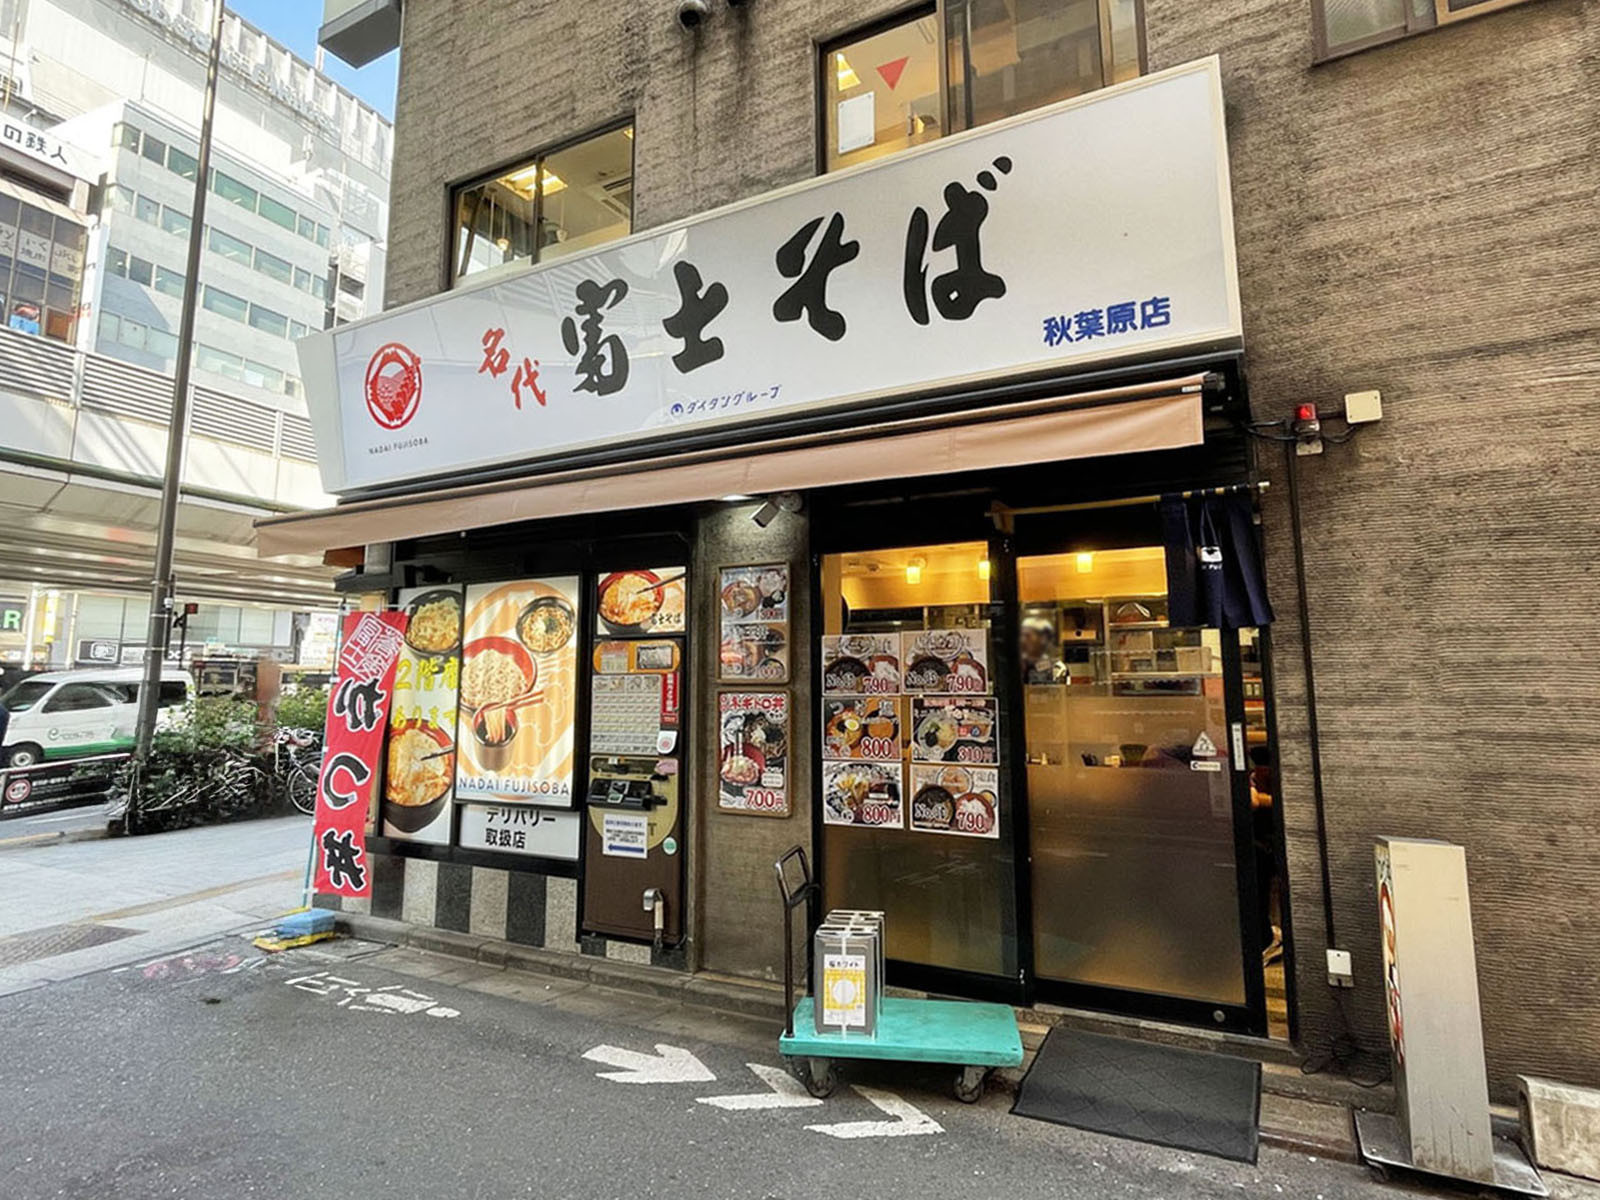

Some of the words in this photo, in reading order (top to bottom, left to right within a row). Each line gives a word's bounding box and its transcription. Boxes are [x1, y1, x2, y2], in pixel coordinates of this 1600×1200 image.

[4, 124, 68, 165] の鉄人
[1043, 296, 1171, 346] 秋葉原店
[478, 328, 547, 410] 名代
[687, 384, 782, 414] ダイタングループ
[459, 776, 500, 790] NADAI
[503, 780, 570, 796] FUJISOBA
[485, 827, 526, 849] 取扱店
